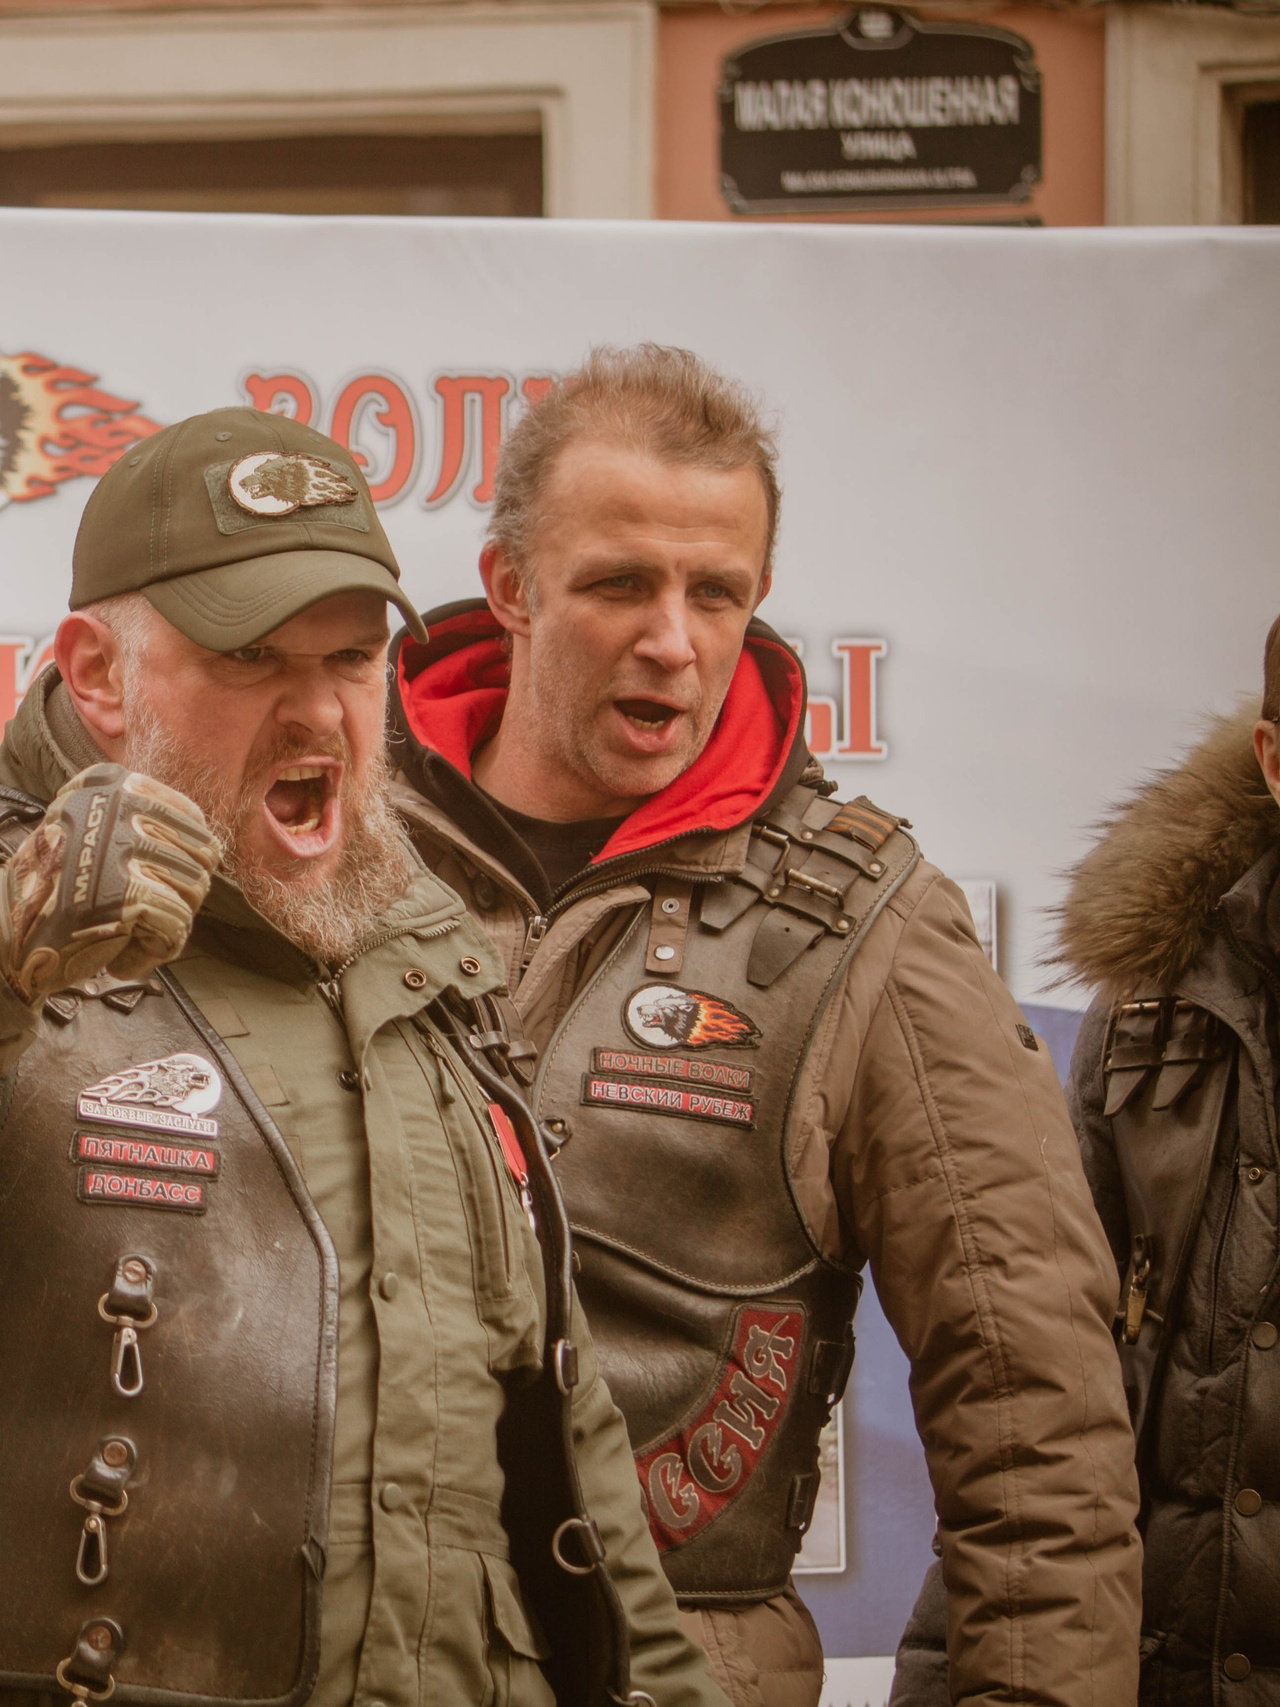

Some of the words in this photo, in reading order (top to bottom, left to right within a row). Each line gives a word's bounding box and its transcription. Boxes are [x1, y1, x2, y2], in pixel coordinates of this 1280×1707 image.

[600, 1052, 685, 1077] НОЧНЫЕ
[688, 1061, 750, 1089] ВОЛКИ
[86, 1102, 102, 1115] ЗА
[106, 1105, 154, 1124] БОЕВЫЕ
[159, 1113, 213, 1133] ЗАСЛУГИ
[688, 1094, 751, 1121] РУБЕЖ
[84, 1137, 211, 1170] ПЯТНАШКА
[90, 1174, 199, 1203] ДОНБАСС
[648, 1314, 796, 1530] ССИЯ
